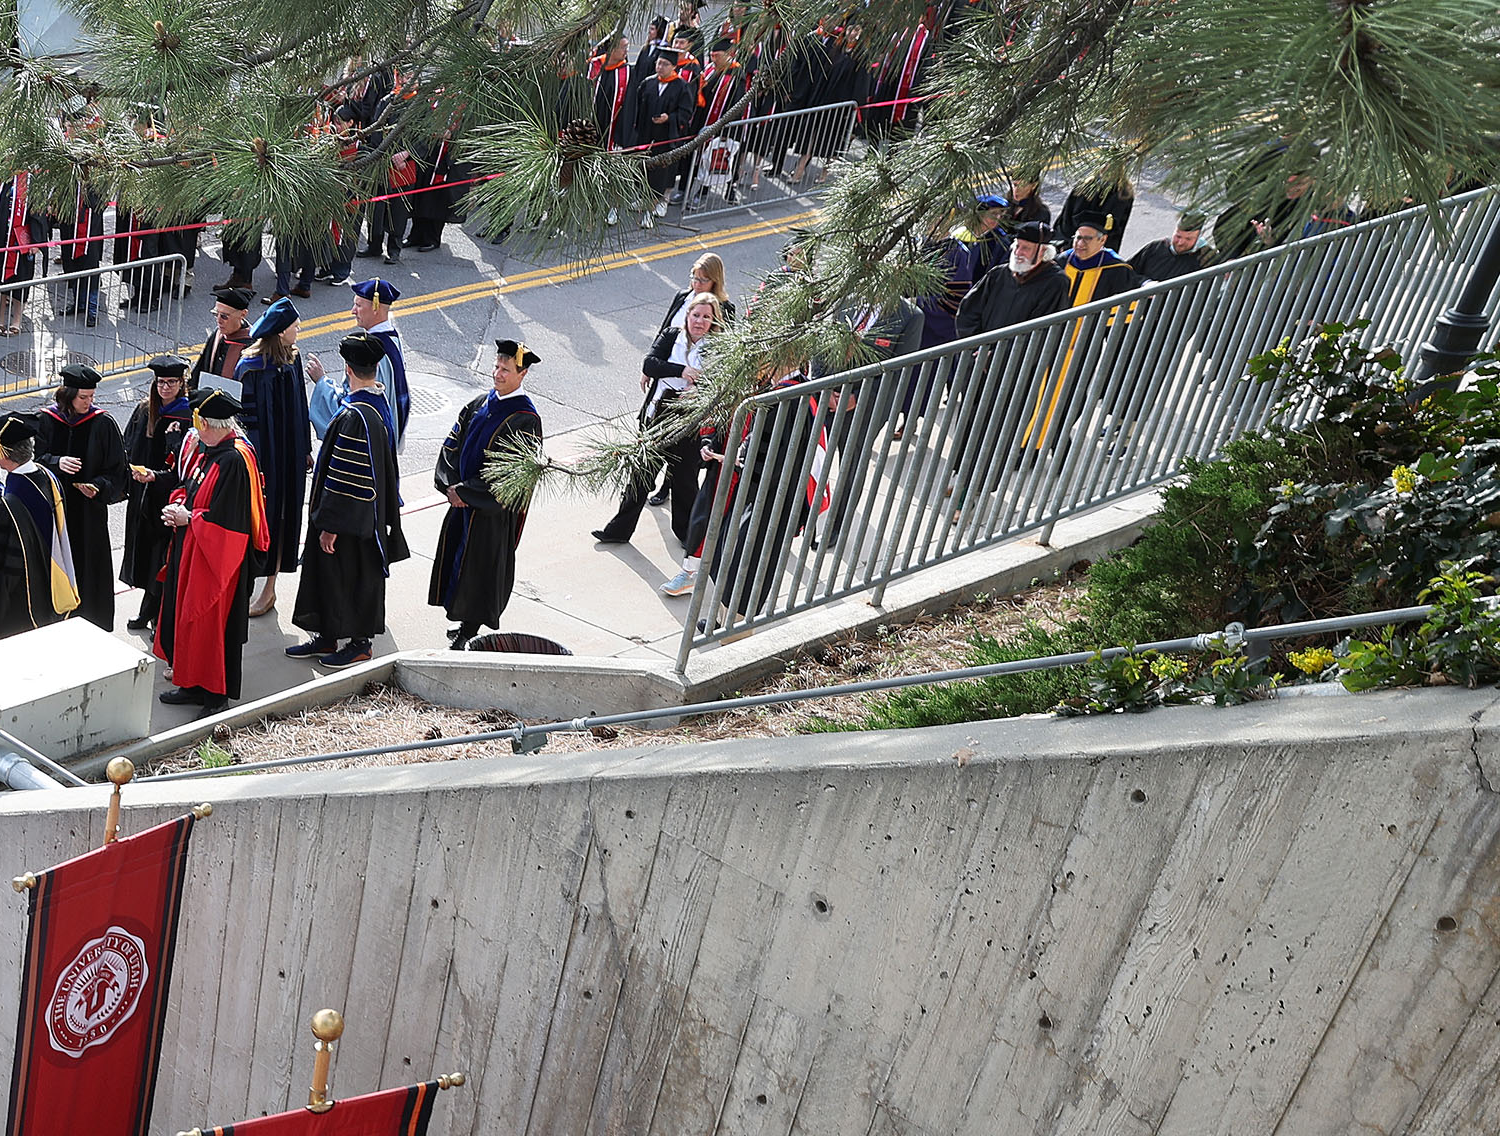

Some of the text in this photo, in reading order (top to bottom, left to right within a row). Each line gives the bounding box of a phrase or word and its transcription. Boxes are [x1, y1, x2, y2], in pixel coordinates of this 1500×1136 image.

[54, 937, 140, 1023] THE UNIVERTY OF UTAH
